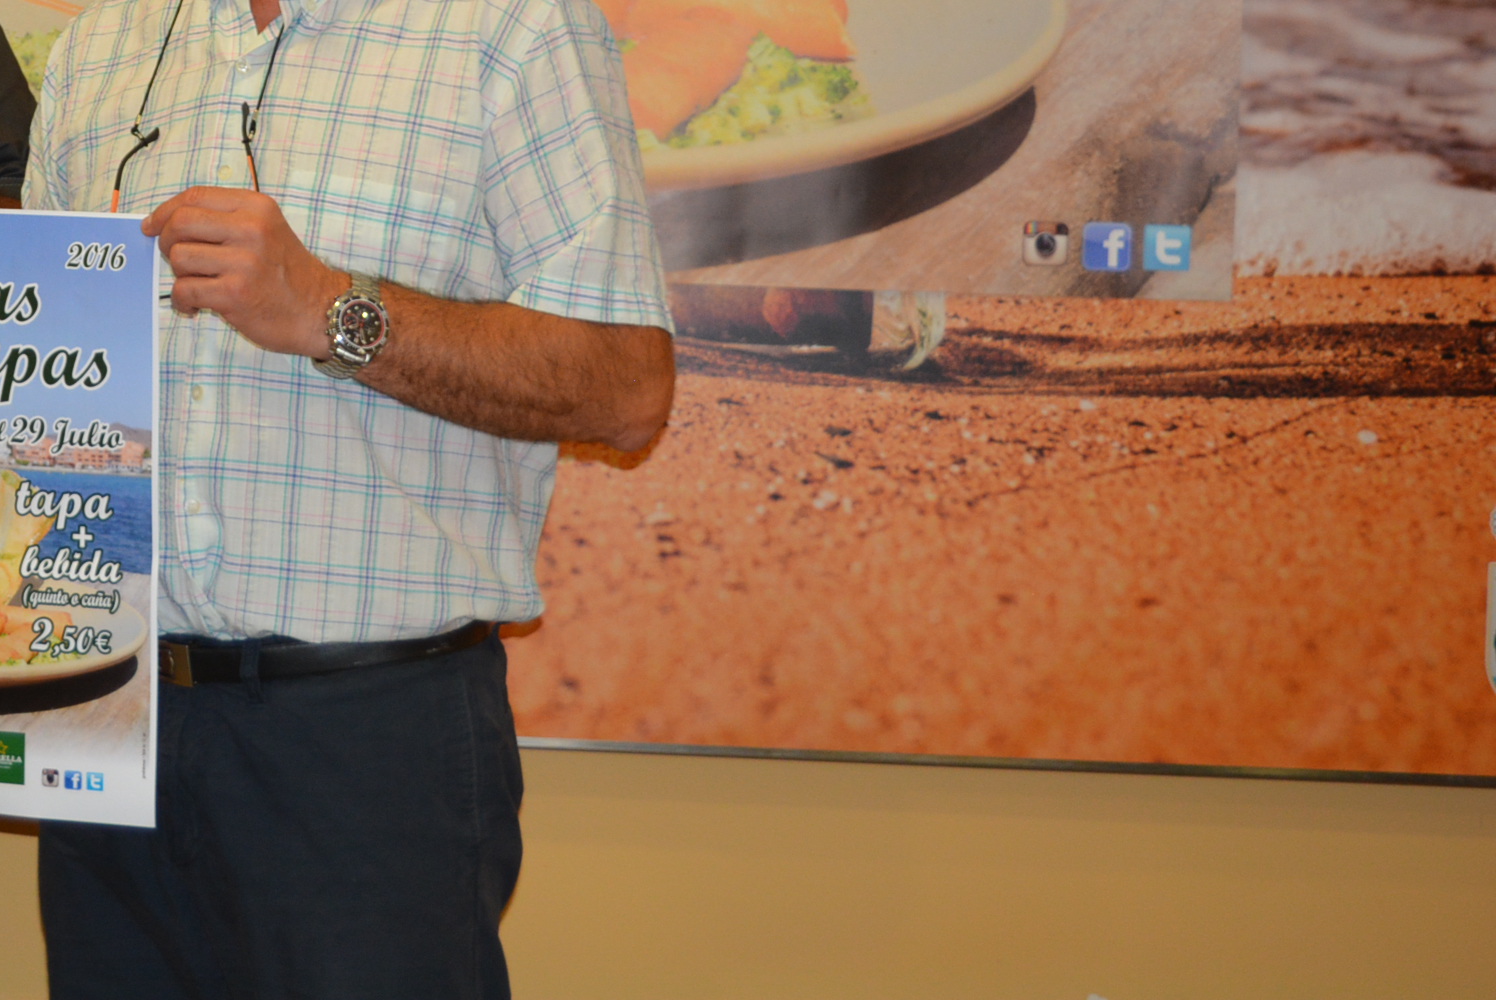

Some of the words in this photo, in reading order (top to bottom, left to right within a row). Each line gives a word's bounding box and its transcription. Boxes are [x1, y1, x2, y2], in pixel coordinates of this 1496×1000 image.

[65, 241, 126, 271] 2016
[11, 415, 45, 444] 29
[51, 418, 124, 456] Julio
[15, 480, 114, 530] tapa
[71, 525, 94, 549] +
[20, 545, 123, 584] bebida
[22, 584, 69, 609] (quinto
[70, 594, 79, 607] o
[81, 590, 120, 614] caña)
[30, 617, 112, 657] 2,50€
